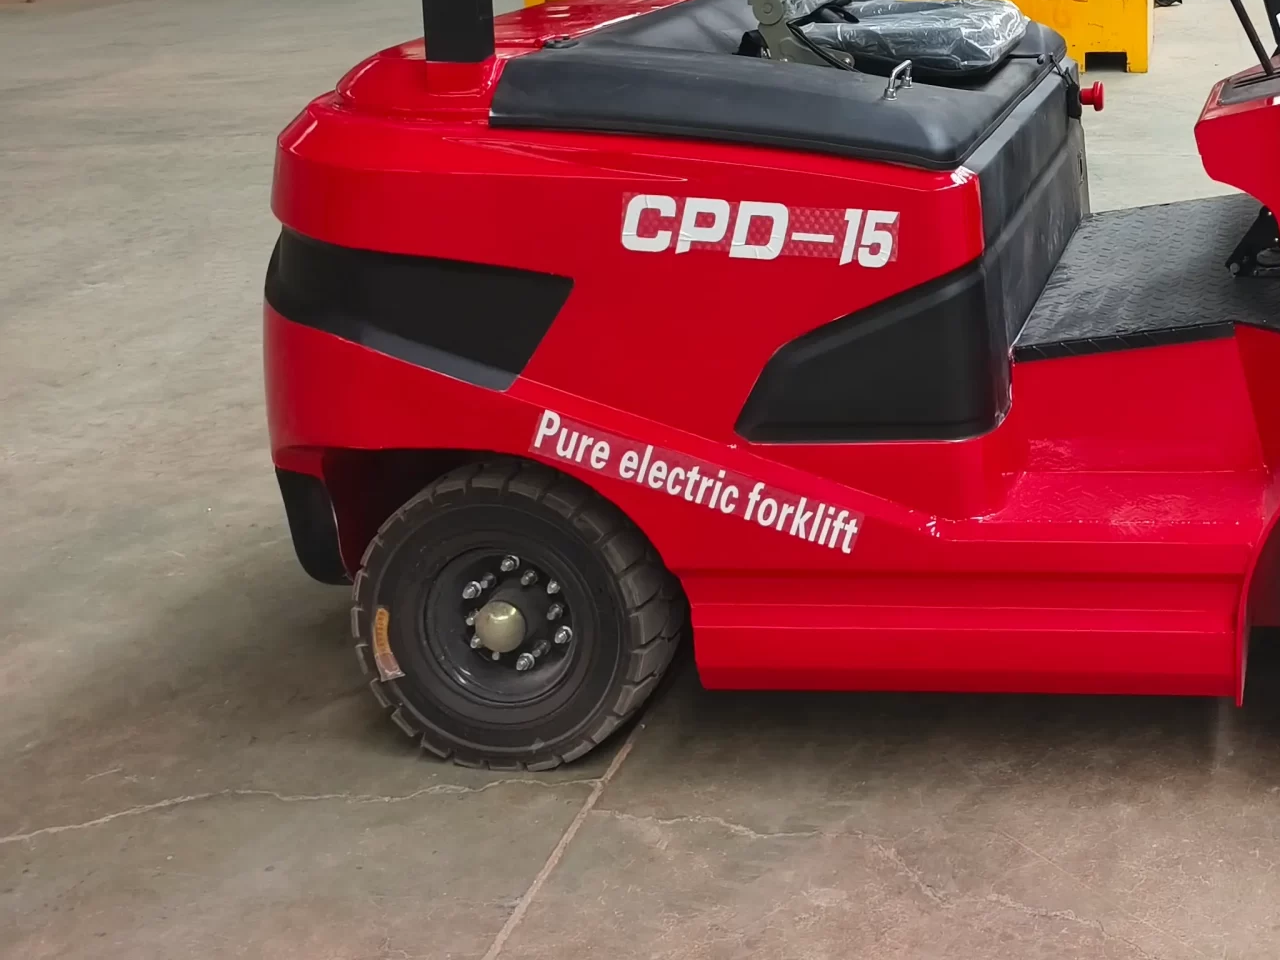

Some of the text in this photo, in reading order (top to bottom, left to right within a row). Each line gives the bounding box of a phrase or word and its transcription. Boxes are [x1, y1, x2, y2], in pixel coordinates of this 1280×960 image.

[621, 194, 900, 269] CPD-15
[533, 409, 859, 554] Pure electric forklift
